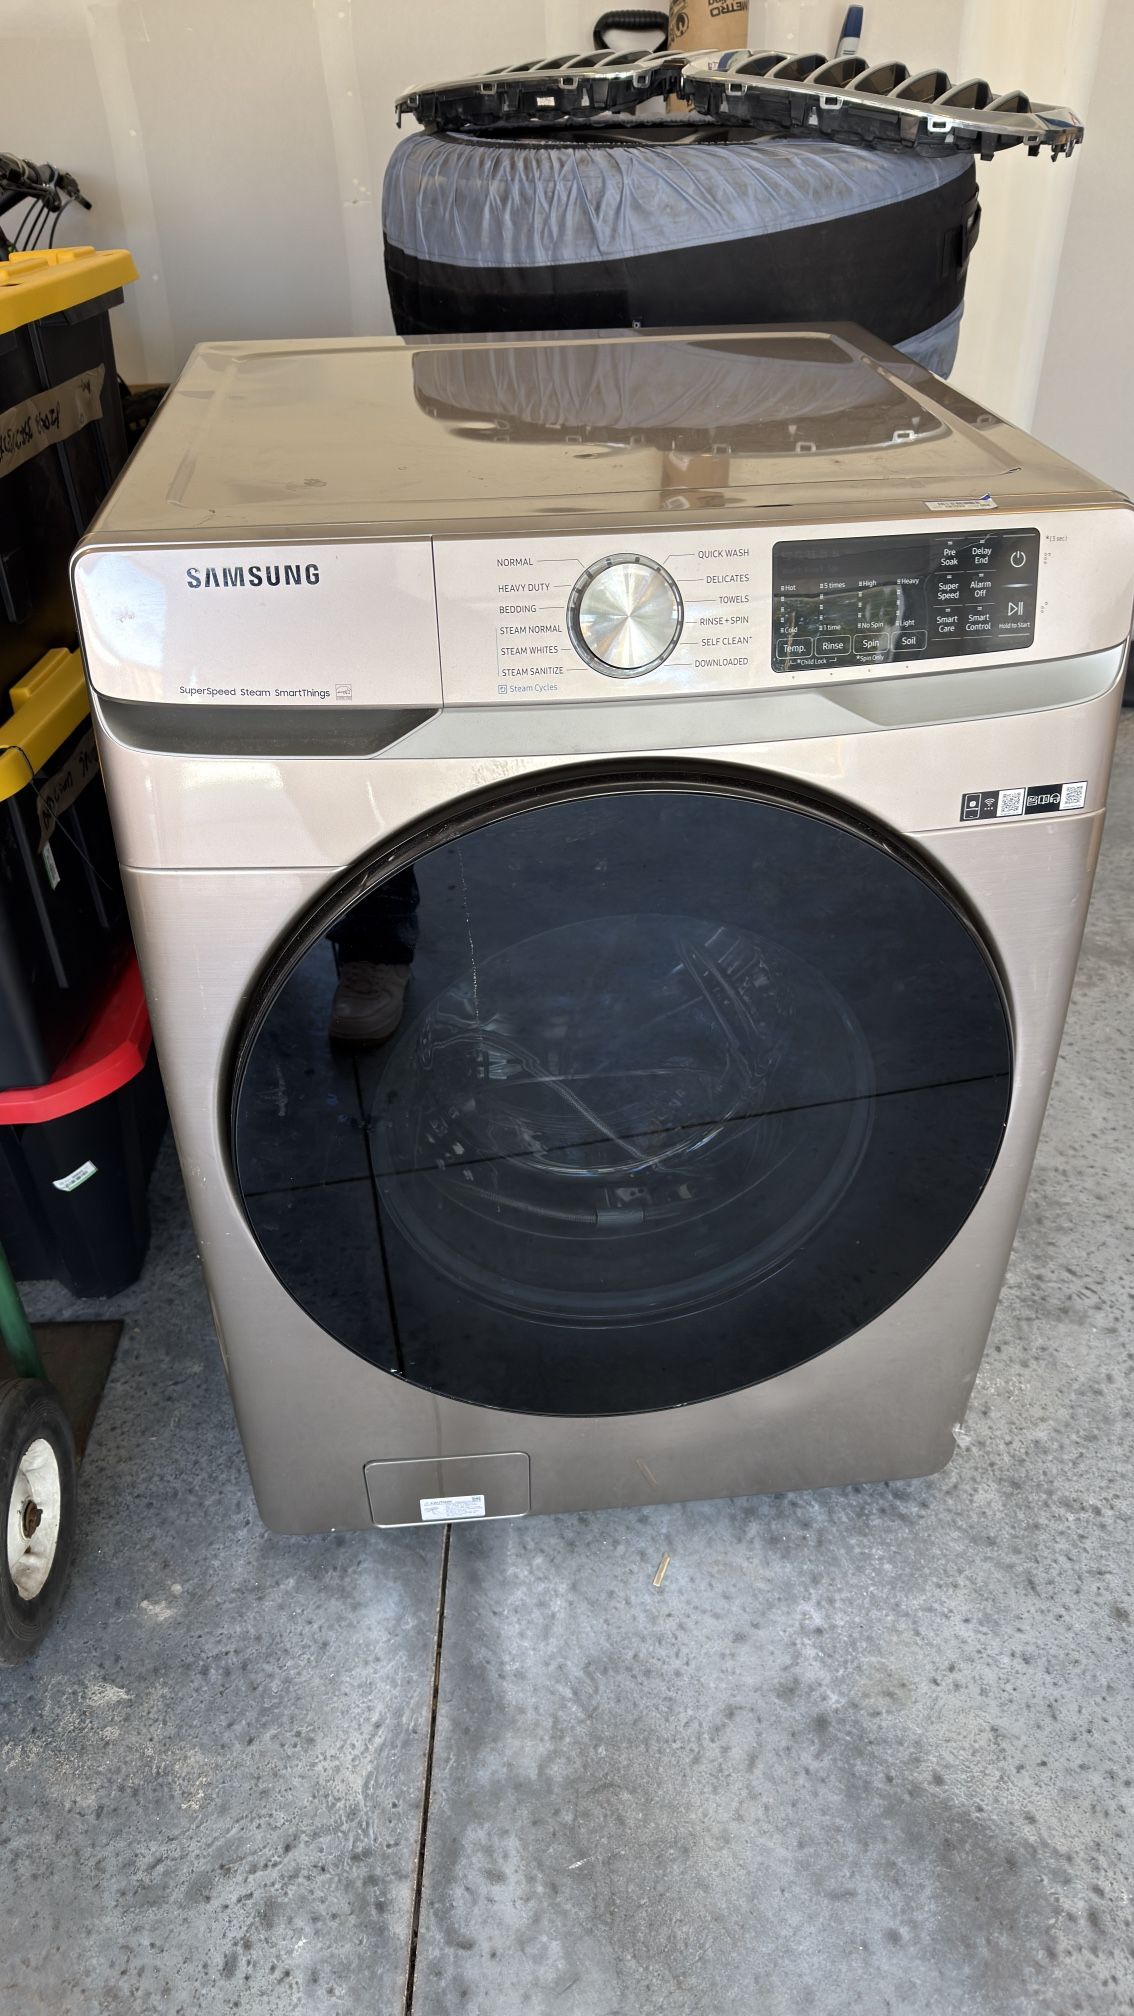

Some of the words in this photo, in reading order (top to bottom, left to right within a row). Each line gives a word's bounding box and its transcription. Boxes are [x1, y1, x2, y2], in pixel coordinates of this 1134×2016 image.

[698, 550, 723, 559] QUICK
[724, 548, 750, 558] WASH
[972, 547, 992, 556] Delay
[497, 557, 534, 568] NORMAL
[186, 564, 320, 588] SAMSUNG
[706, 574, 750, 584] DELICATES
[498, 583, 526, 593] HEAVY
[528, 582, 550, 592] DUTY
[938, 582, 959, 592] Super
[970, 580, 992, 588] Alarm
[718, 594, 749, 604] TOWELS
[937, 592, 960, 601] Speed
[499, 604, 537, 614] BEDDING
[500, 626, 525, 635] STEAM
[527, 624, 562, 634] NORMAL
[938, 624, 955, 632] Care
[966, 622, 992, 630] Control
[701, 637, 721, 647] SELF
[862, 639, 880, 648] Spin
[902, 636, 916, 645] Soil
[501, 646, 526, 656] STEAM
[528, 646, 558, 655] WHITES
[783, 645, 806, 653] Temp.
[822, 642, 844, 650] Rinse
[694, 658, 748, 668] DOWNLOADED
[502, 667, 527, 677] STEAM
[529, 666, 564, 676] SANITIZE
[179, 686, 236, 697] SuperSpeed
[240, 688, 271, 698] Steam
[274, 688, 330, 700] SmartThings
[509, 684, 534, 693] Steam
[534, 683, 558, 694] Cycles
